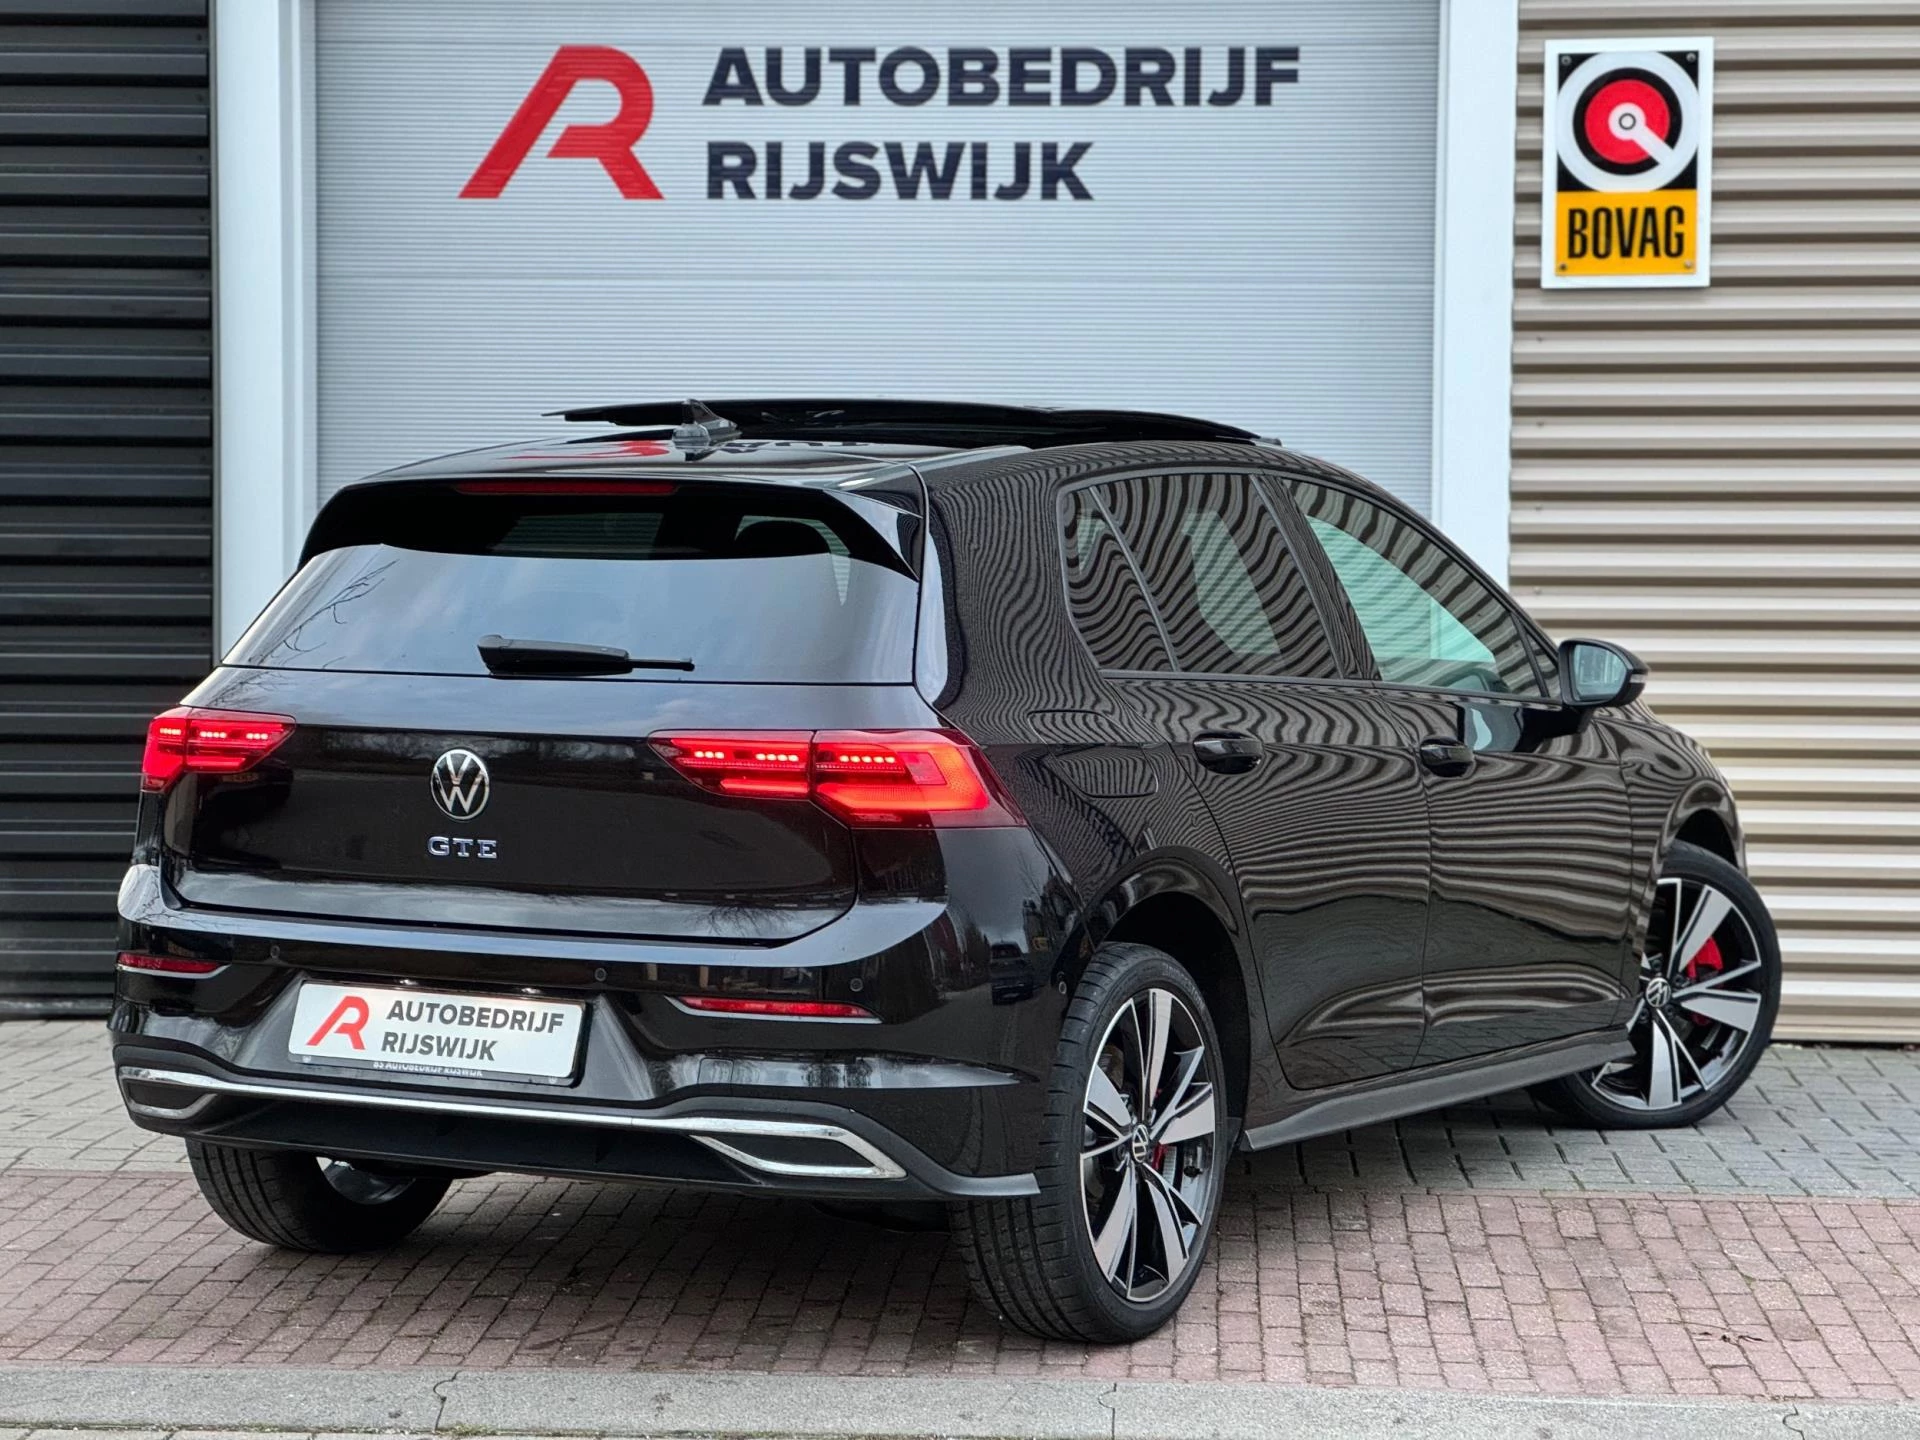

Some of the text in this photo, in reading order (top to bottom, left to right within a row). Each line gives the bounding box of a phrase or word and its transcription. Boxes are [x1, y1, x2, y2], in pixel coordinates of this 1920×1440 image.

[703, 47, 1300, 106] AUTOBEDRIJF
[708, 142, 1092, 200] RIJSWIJK
[1567, 205, 1686, 260] BOVAG
[427, 836, 497, 859] GTE
[386, 1000, 564, 1033] AUTOBEDRIJF
[381, 1031, 498, 1061] RIJSWIJK
